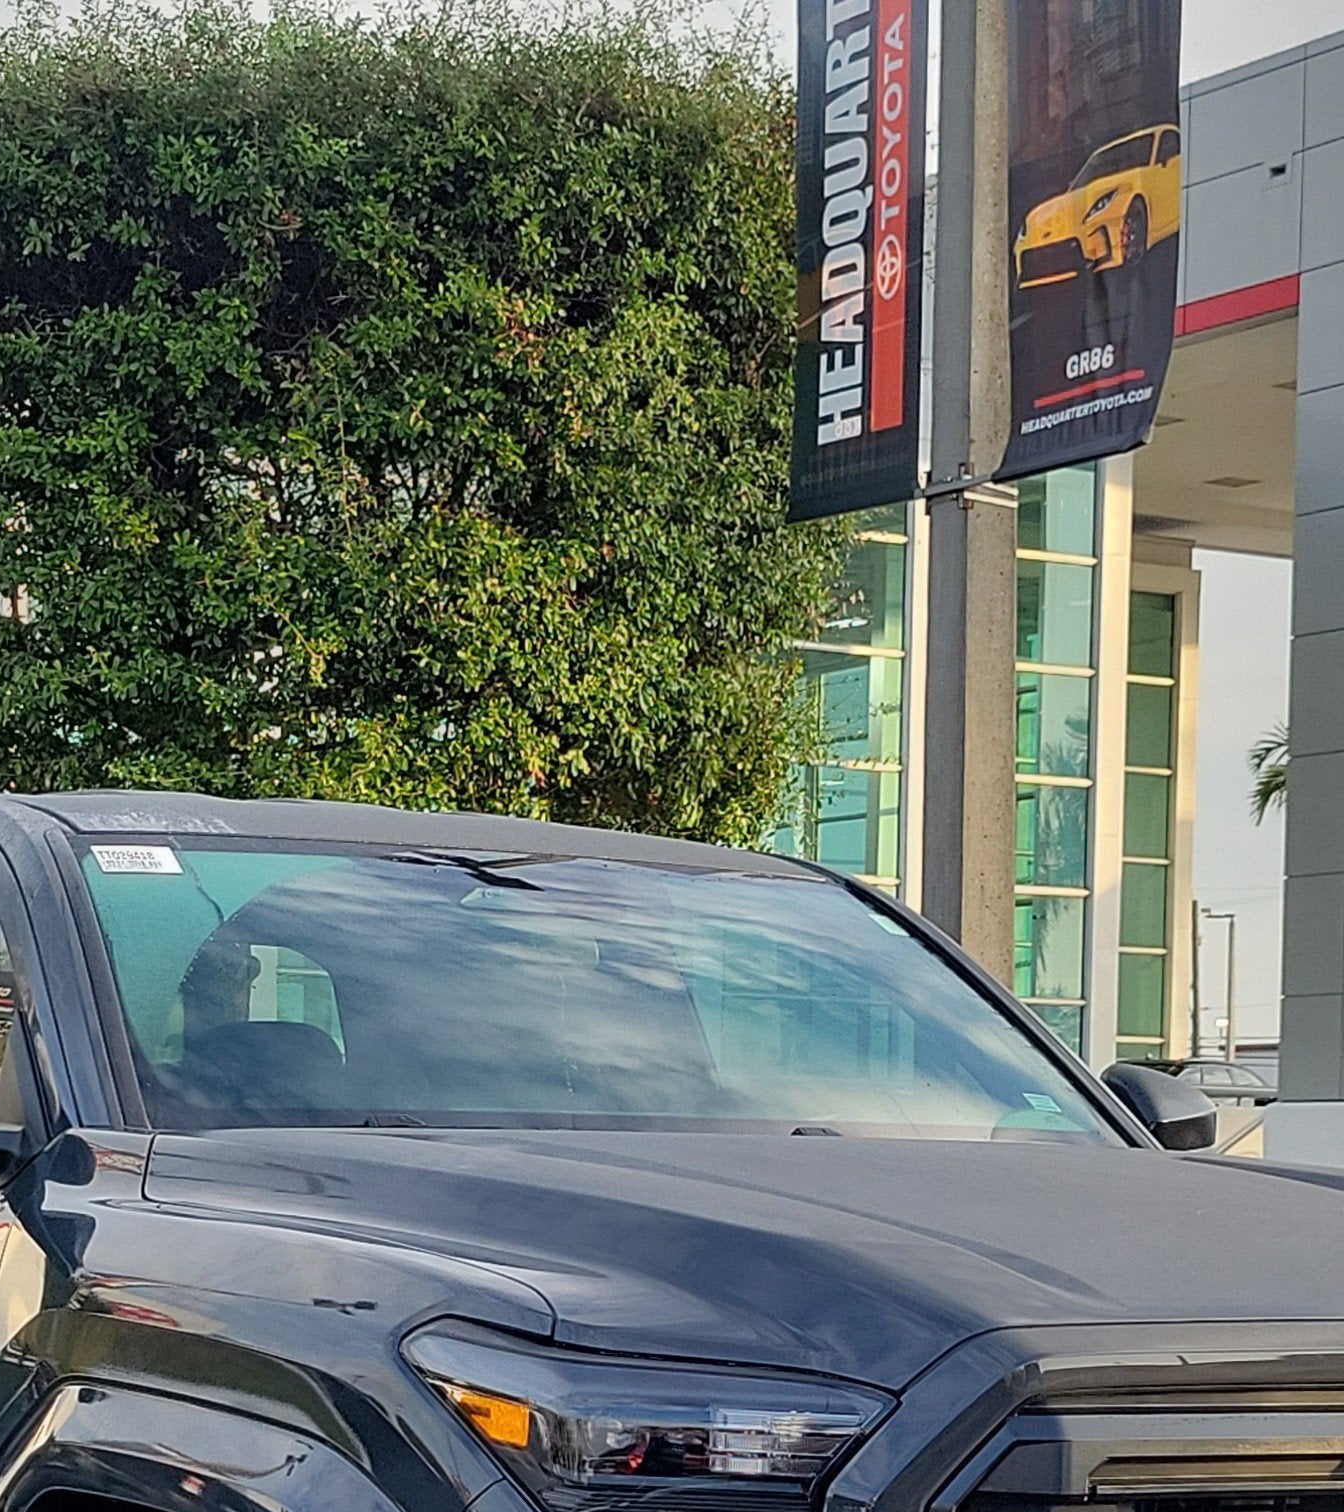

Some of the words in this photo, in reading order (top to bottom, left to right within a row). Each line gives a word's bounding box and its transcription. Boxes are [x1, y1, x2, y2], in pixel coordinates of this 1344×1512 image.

[880, 12, 906, 231] TOYOTA
[1066, 344, 1115, 379] GR86
[1020, 386, 1154, 435] HEADQUARTERTOYOTA.COM
